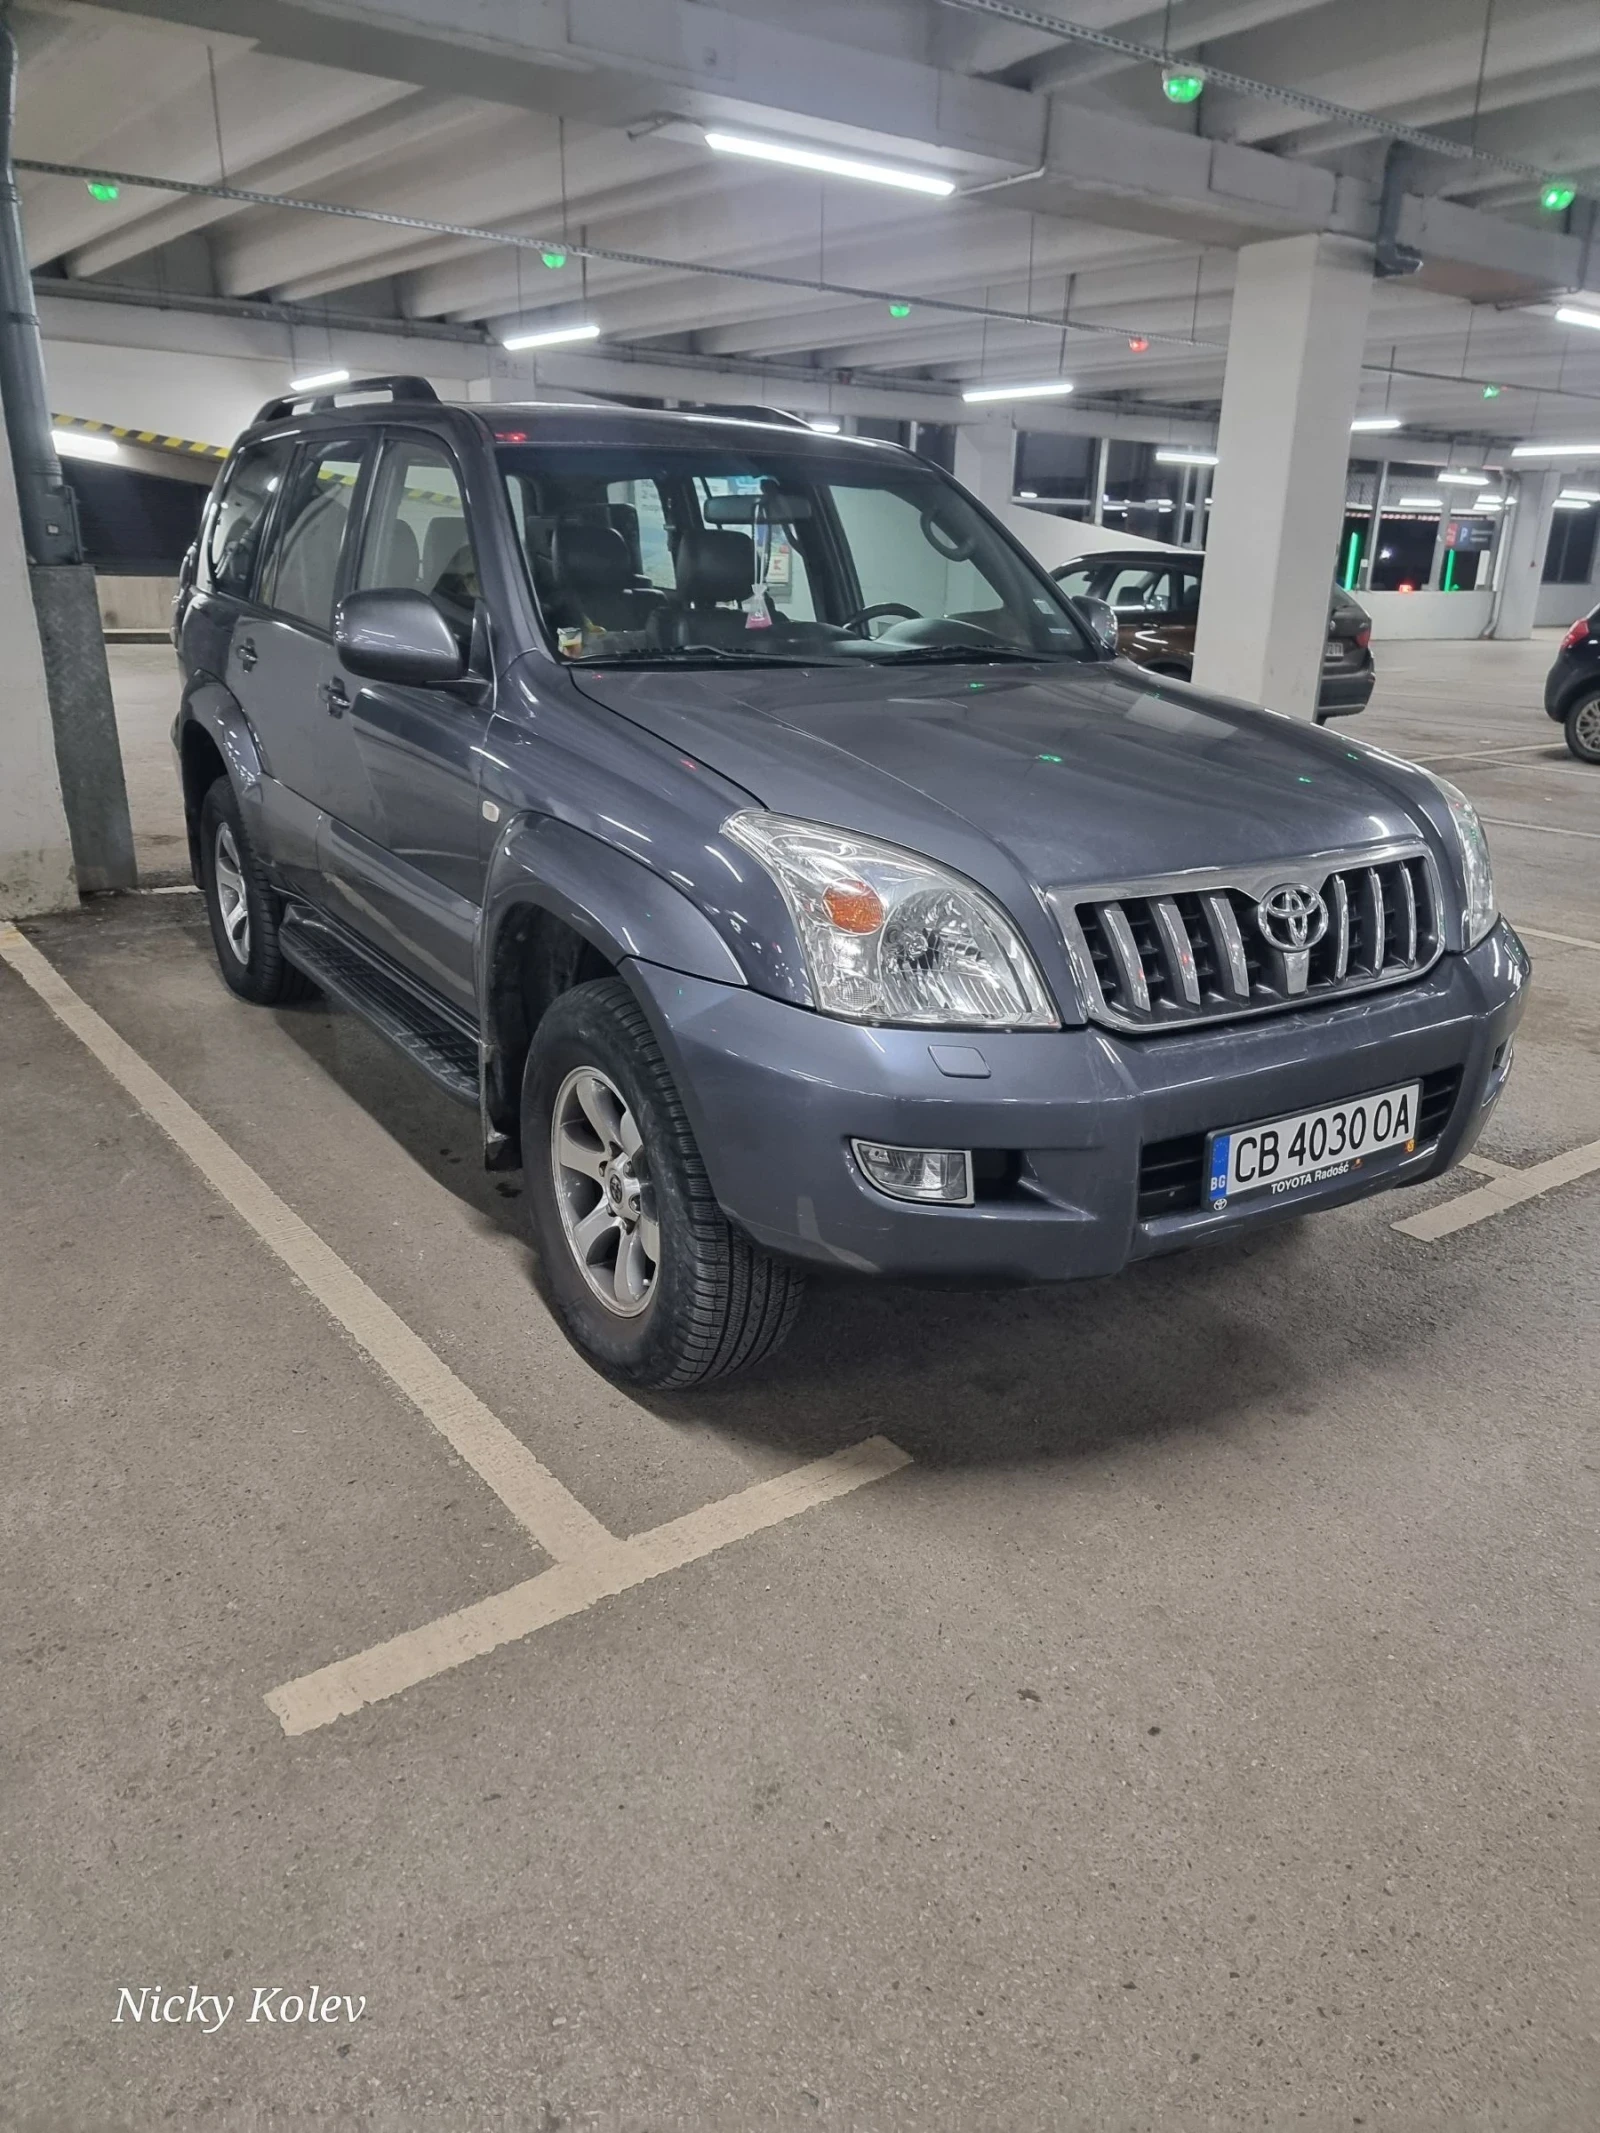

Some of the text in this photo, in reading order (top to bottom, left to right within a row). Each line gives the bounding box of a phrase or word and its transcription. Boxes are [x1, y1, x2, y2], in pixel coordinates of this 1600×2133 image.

[1234, 1094, 1410, 1183] CB 4030 OA
[1210, 1174, 1226, 1191] BG
[1271, 1161, 1349, 1195] TOYOTA Radość
